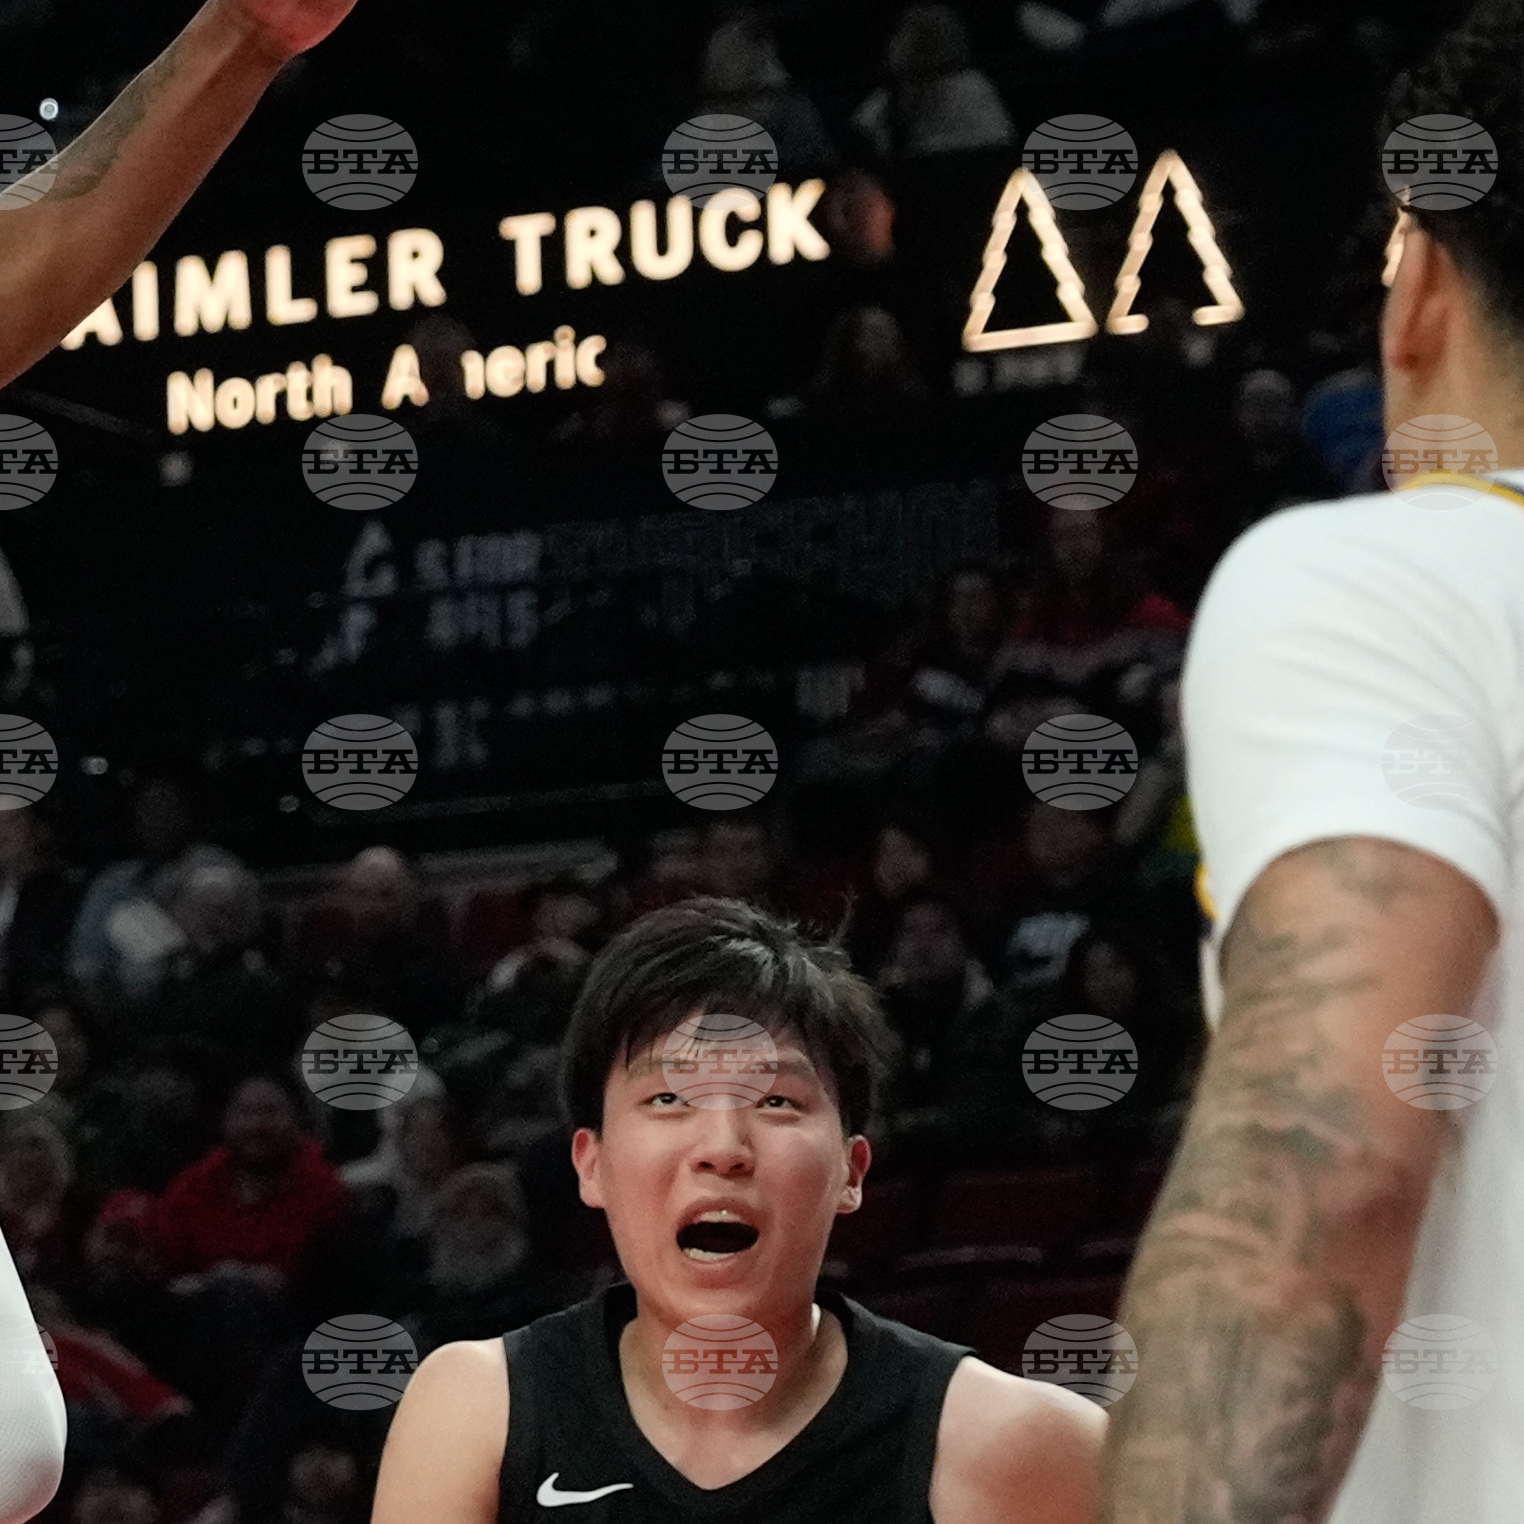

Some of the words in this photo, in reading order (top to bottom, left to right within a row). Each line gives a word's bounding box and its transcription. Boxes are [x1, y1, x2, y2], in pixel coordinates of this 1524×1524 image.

[60, 228, 448, 352] AIMLER
[498, 177, 832, 298] TRUCK
[166, 352, 354, 437] North
